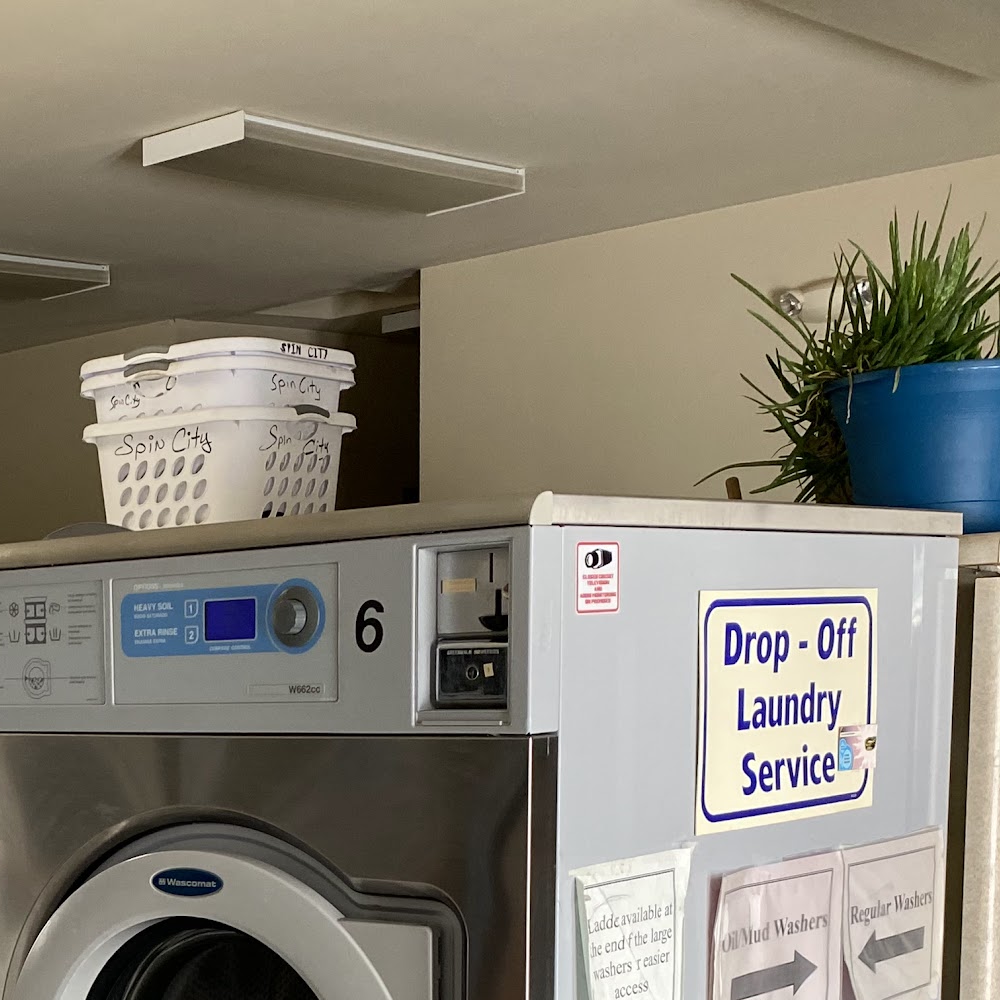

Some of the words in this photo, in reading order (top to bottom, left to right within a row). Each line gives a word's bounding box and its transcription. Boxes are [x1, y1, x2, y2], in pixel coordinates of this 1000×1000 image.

[280, 343, 302, 355] SPIN
[271, 373, 296, 395] Spin
[298, 376, 321, 401] City
[114, 433, 165, 461] Spin
[171, 426, 212, 454] City
[258, 424, 292, 451] Spin
[302, 438, 330, 461] City
[133, 603, 157, 612] HEAVY
[157, 602, 173, 611] SOIL
[134, 628, 157, 638] EXTRA
[157, 627, 178, 637] RINSE
[188, 630, 195, 641] 2
[355, 599, 385, 653] 6
[723, 622, 790, 673] Drop
[817, 616, 858, 661] Off
[288, 685, 321, 694] W662cc
[737, 682, 842, 731] Laundry
[742, 745, 836, 797] Service
[166, 878, 217, 888] Wascomat
[620, 904, 662, 926] available
[664, 902, 673, 917] at
[850, 900, 892, 927] Regular
[894, 890, 933, 913] Washers
[773, 913, 829, 938] Washers
[605, 935, 625, 953] end
[634, 931, 648, 947] the
[651, 927, 673, 944] large
[593, 960, 633, 981] washers
[643, 949, 671, 968] easier
[614, 980, 649, 999] access
